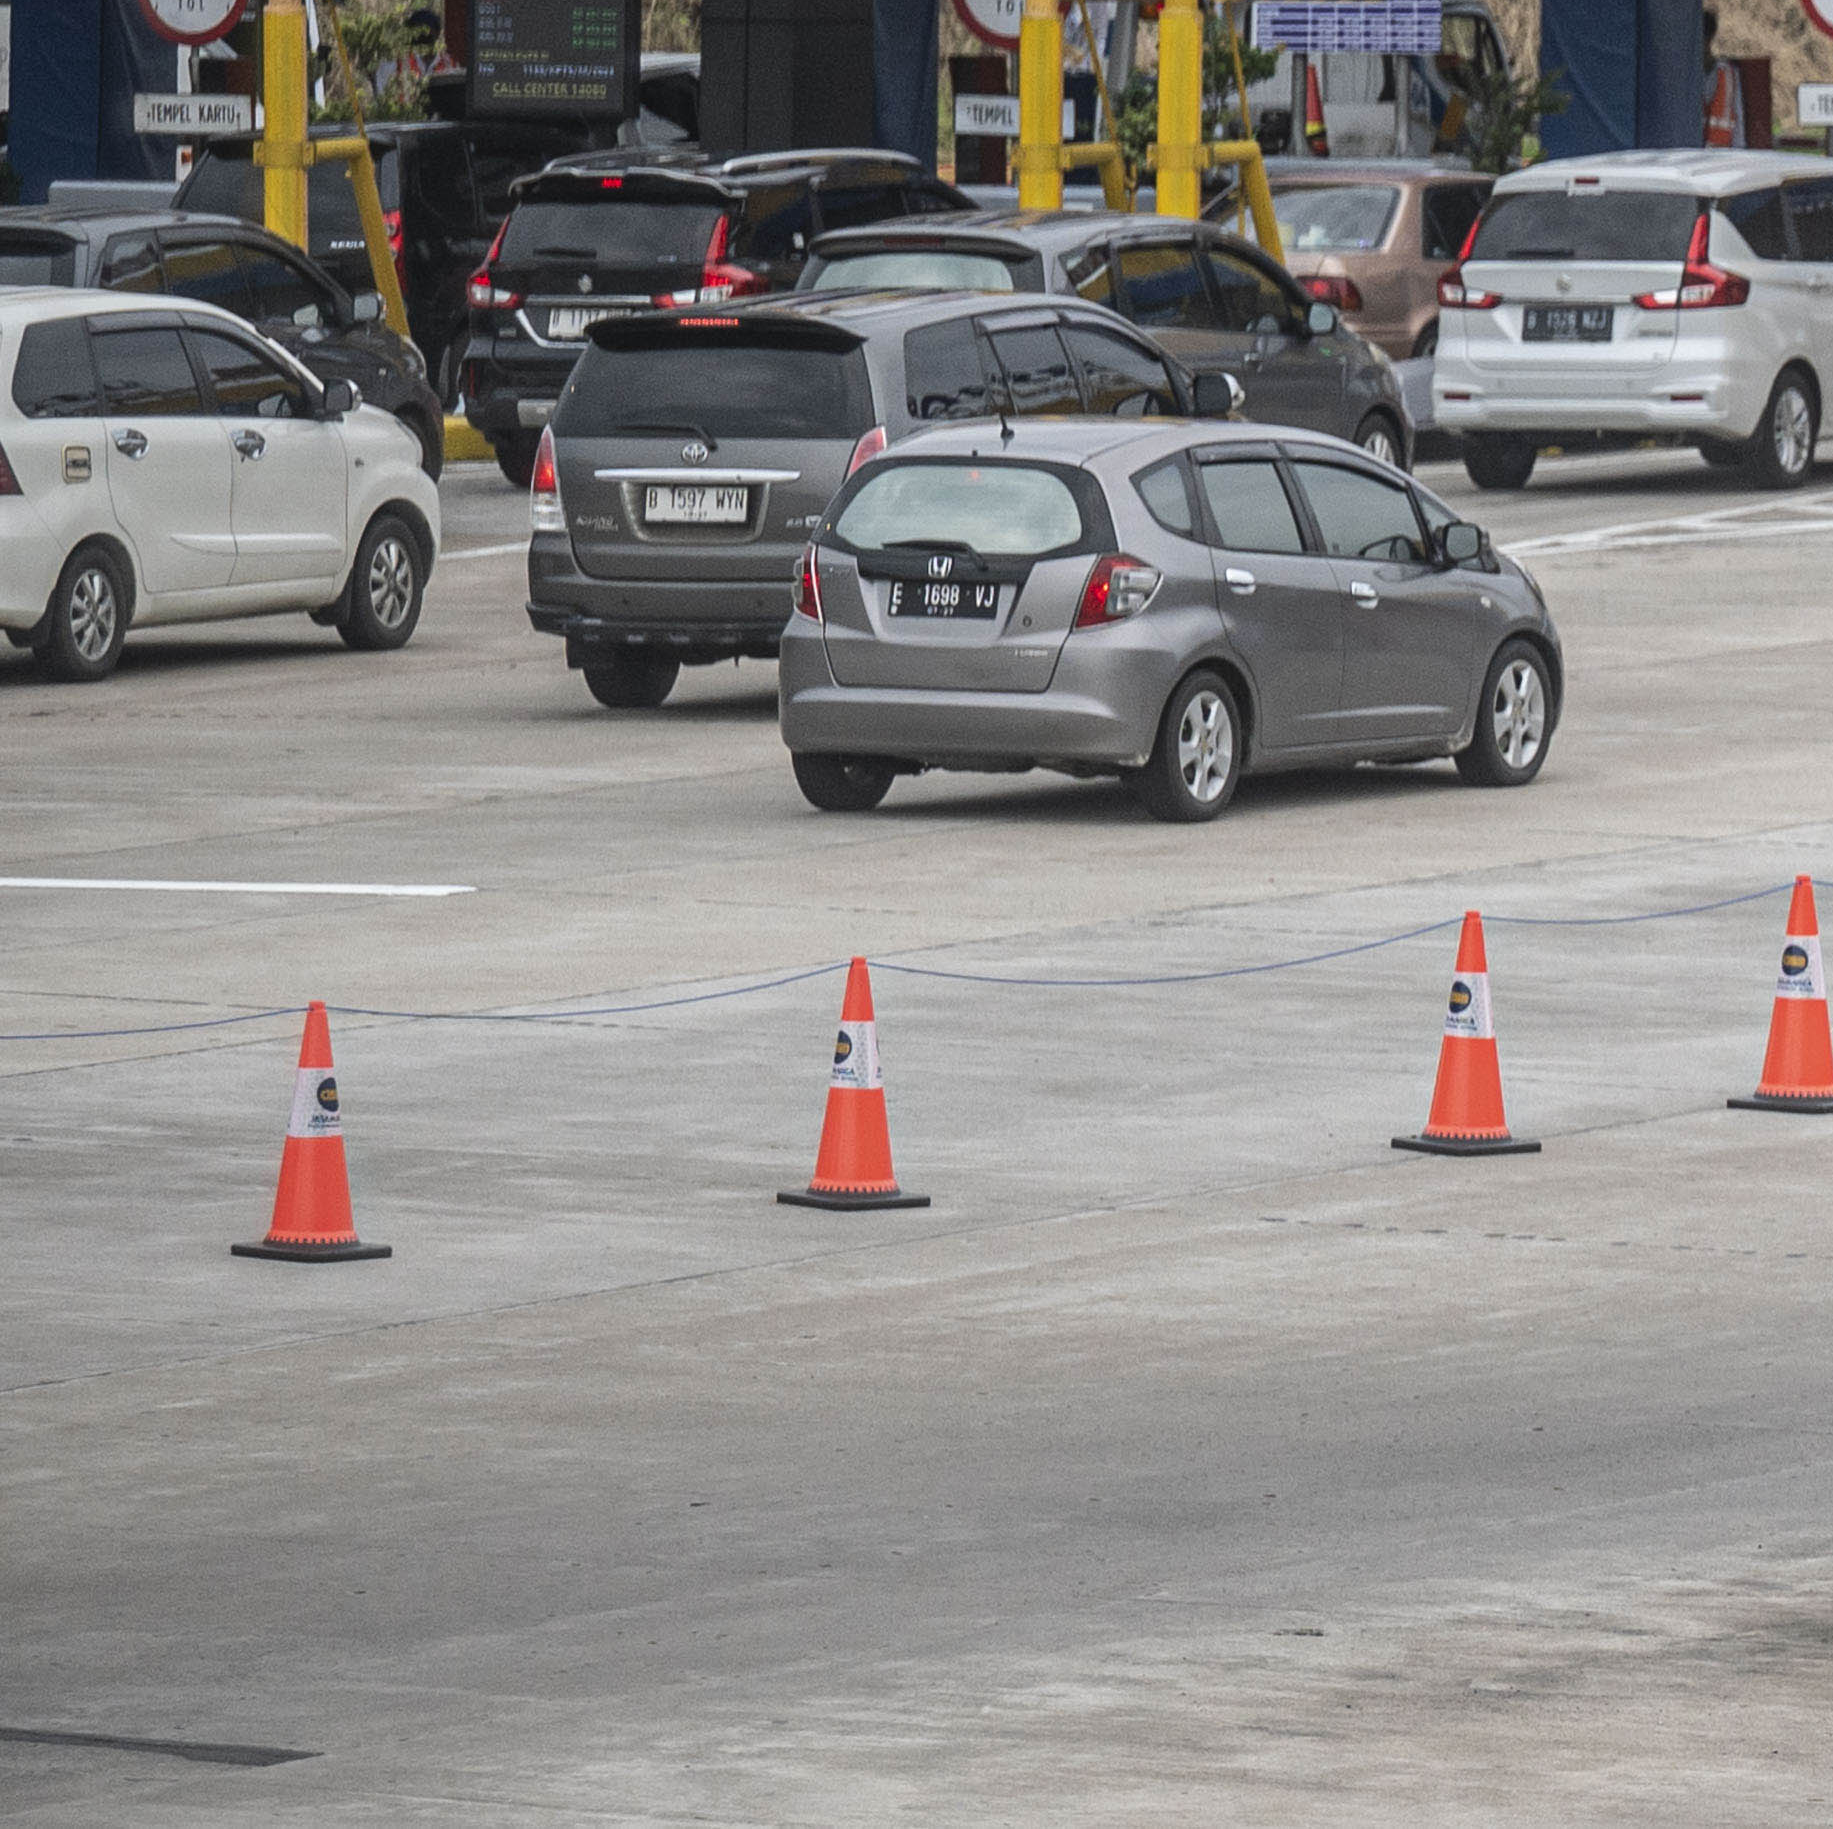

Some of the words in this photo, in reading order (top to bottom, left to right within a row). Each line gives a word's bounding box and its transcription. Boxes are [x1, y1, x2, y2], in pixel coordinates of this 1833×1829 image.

[492, 81, 522, 96] CALL
[523, 82, 569, 96] CENTER
[150, 103, 192, 123] TEMPEL
[197, 103, 236, 125] KARTU
[970, 106, 1013, 127] TEMPEL
[648, 487, 658, 510] B
[670, 487, 706, 510] 1597
[715, 487, 745, 511] WYN
[891, 582, 904, 605] E
[923, 583, 961, 606] 1698
[975, 584, 995, 608] VJ
